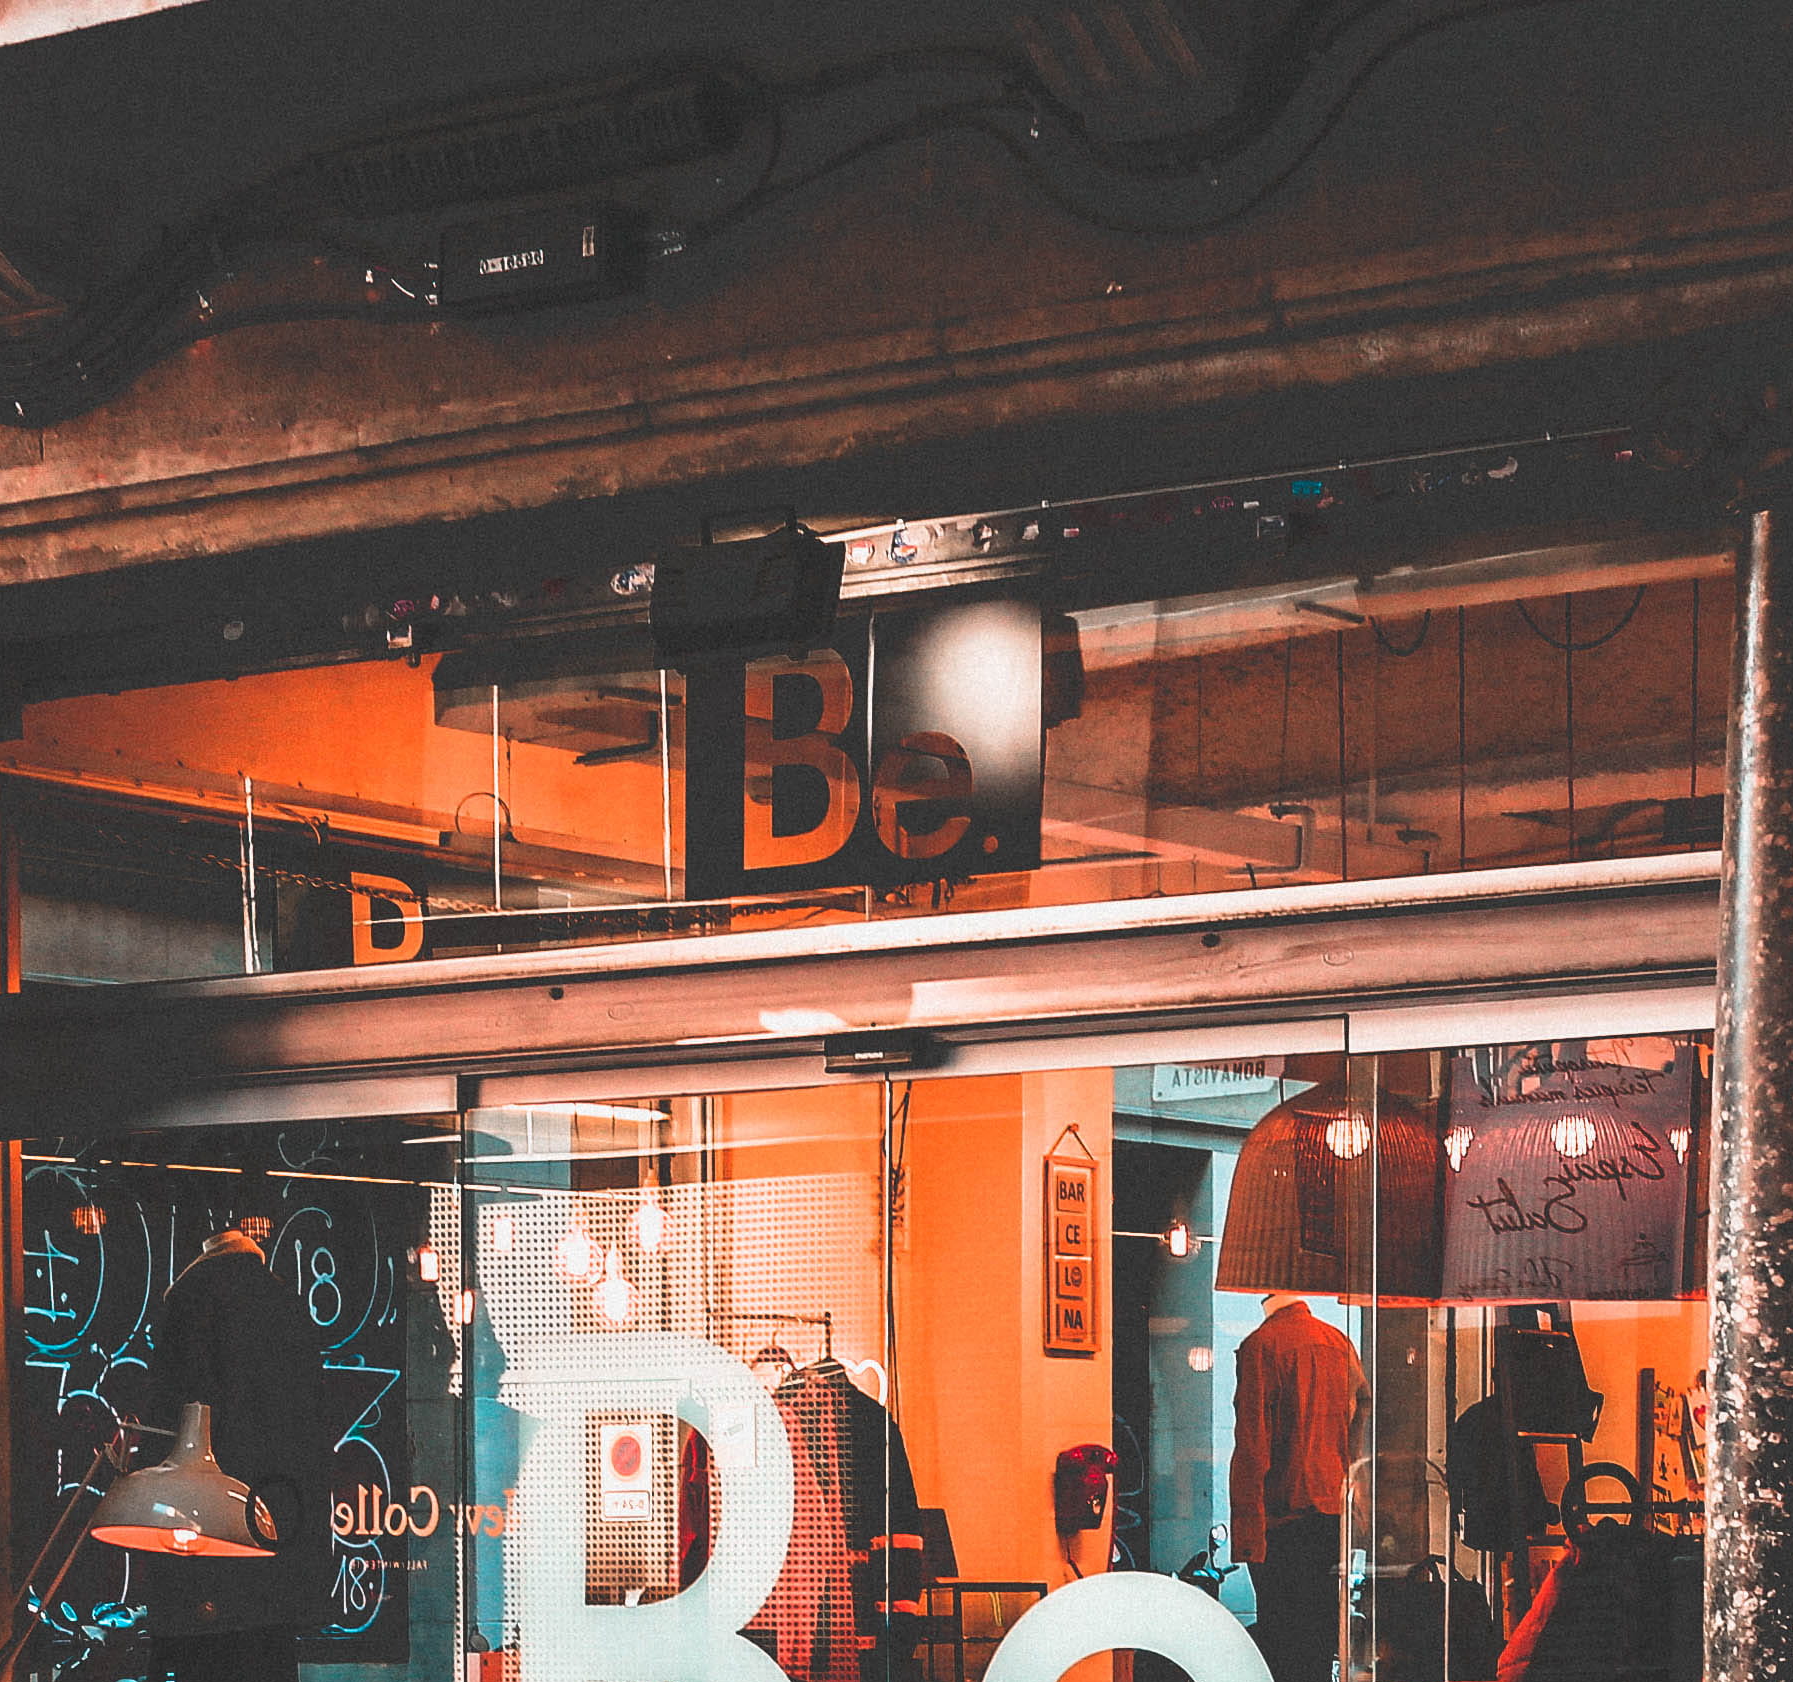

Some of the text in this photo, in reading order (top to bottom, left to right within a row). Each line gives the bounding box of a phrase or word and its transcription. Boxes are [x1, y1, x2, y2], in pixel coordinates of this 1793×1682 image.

[1059, 1180, 1085, 1203] BAR
[1065, 1223, 1081, 1245] CE
[1063, 1308, 1084, 1330] NA
